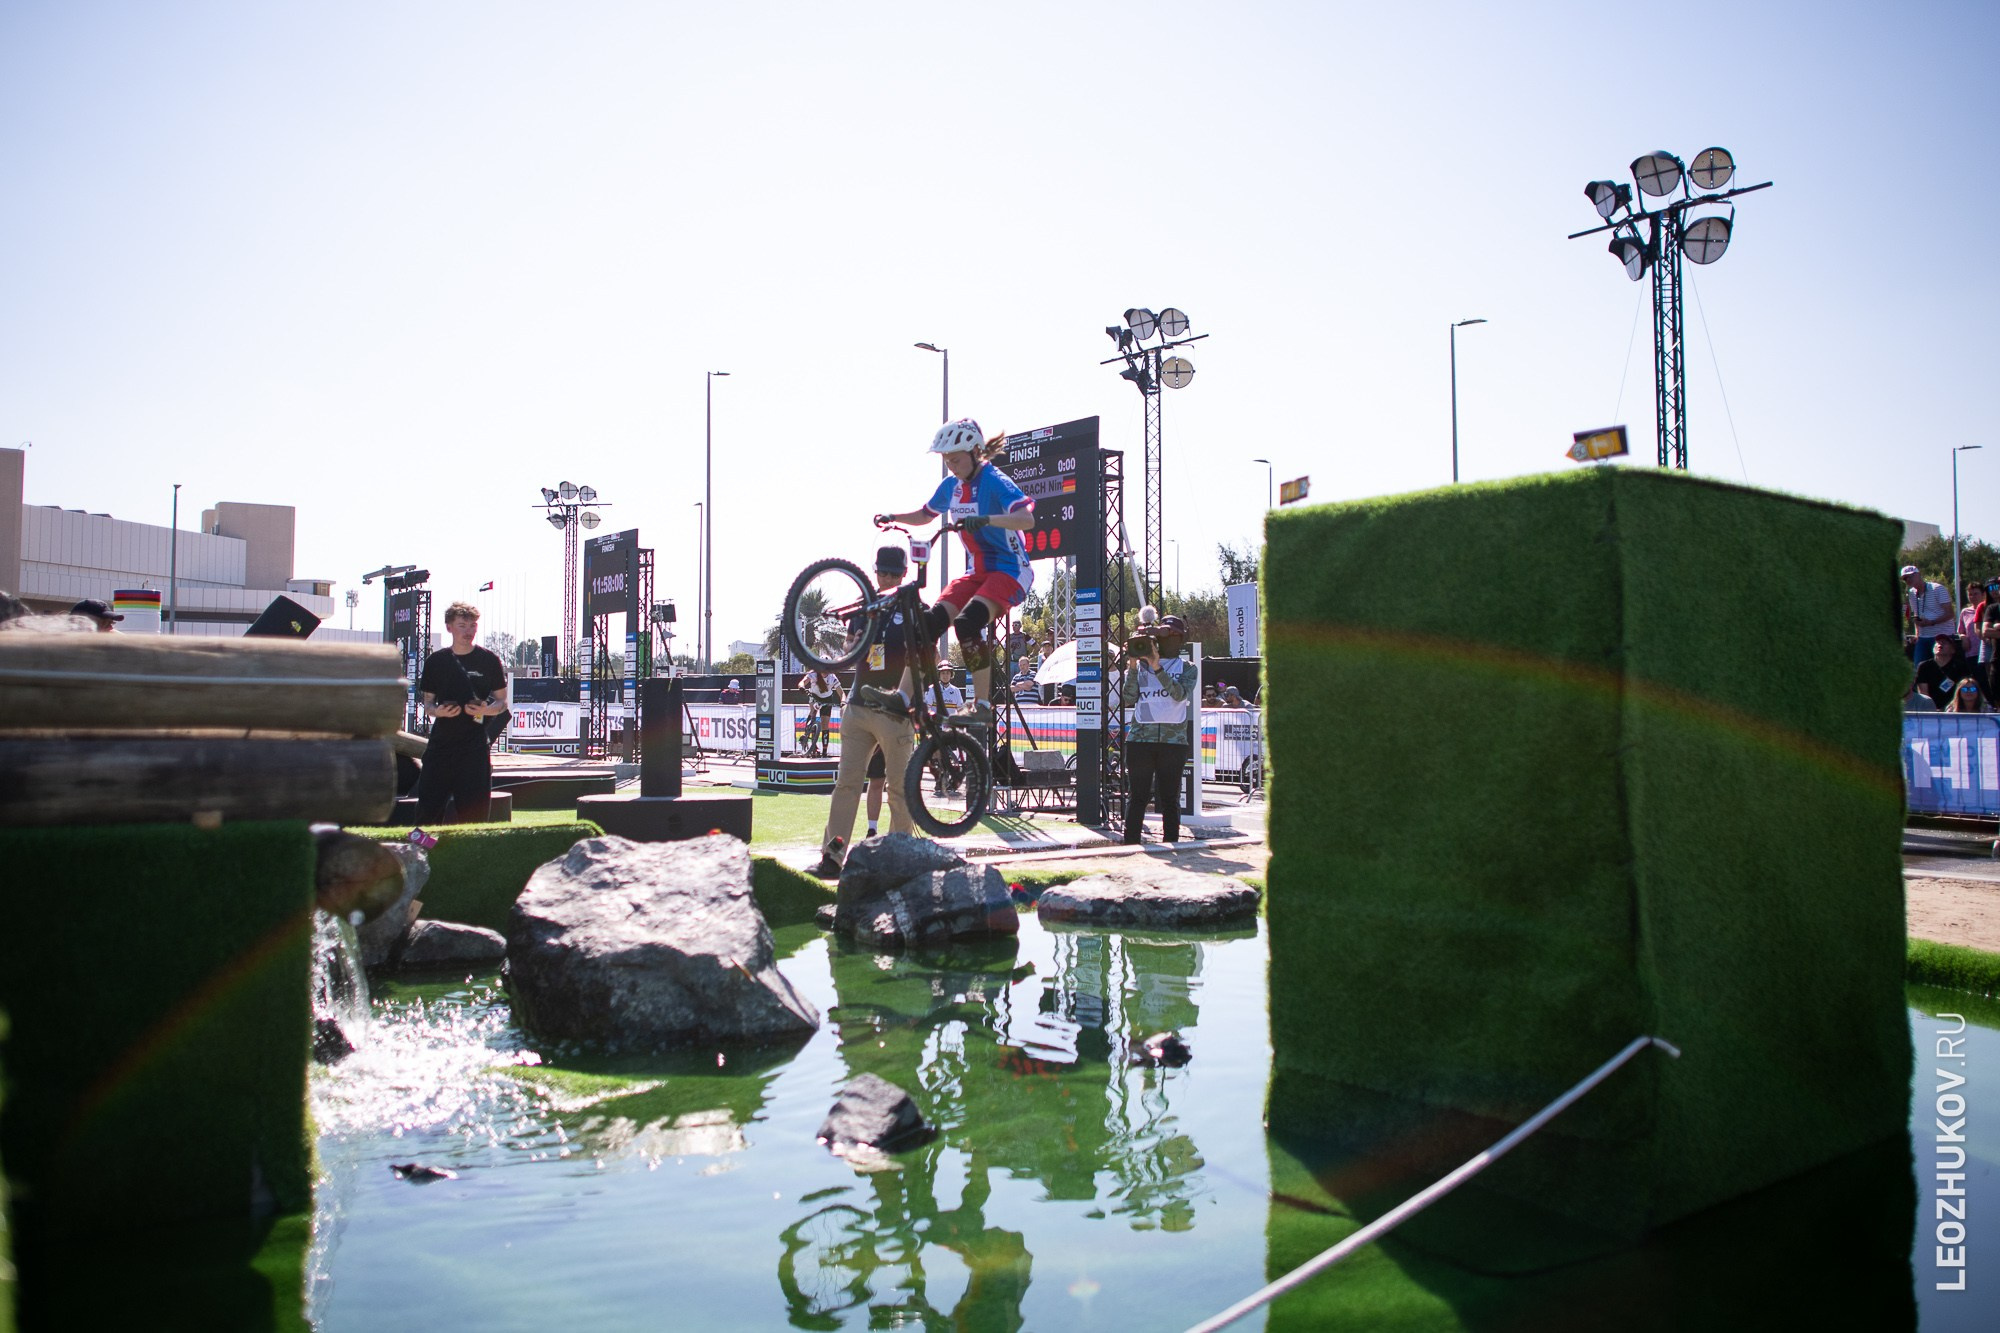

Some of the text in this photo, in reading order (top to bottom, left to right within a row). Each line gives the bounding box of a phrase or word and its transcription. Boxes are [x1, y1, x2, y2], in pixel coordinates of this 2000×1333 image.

[1009, 445, 1040, 463] FINISH
[1057, 457, 1076, 472] 0:00
[1048, 479, 1063, 492] Nin
[1061, 505, 1074, 521] 30
[602, 544, 615, 553] FINISH
[1009, 536, 1030, 568] saza
[592, 573, 624, 595] 11:58:08
[1236, 607, 1245, 637] dhabi
[757, 679, 774, 688] START
[760, 689, 770, 713] 3
[1080, 701, 1095, 710] UCI
[526, 710, 564, 729] TISSOT
[711, 717, 756, 739] TISSO
[554, 744, 575, 754] UCI
[768, 770, 786, 783] UCI
